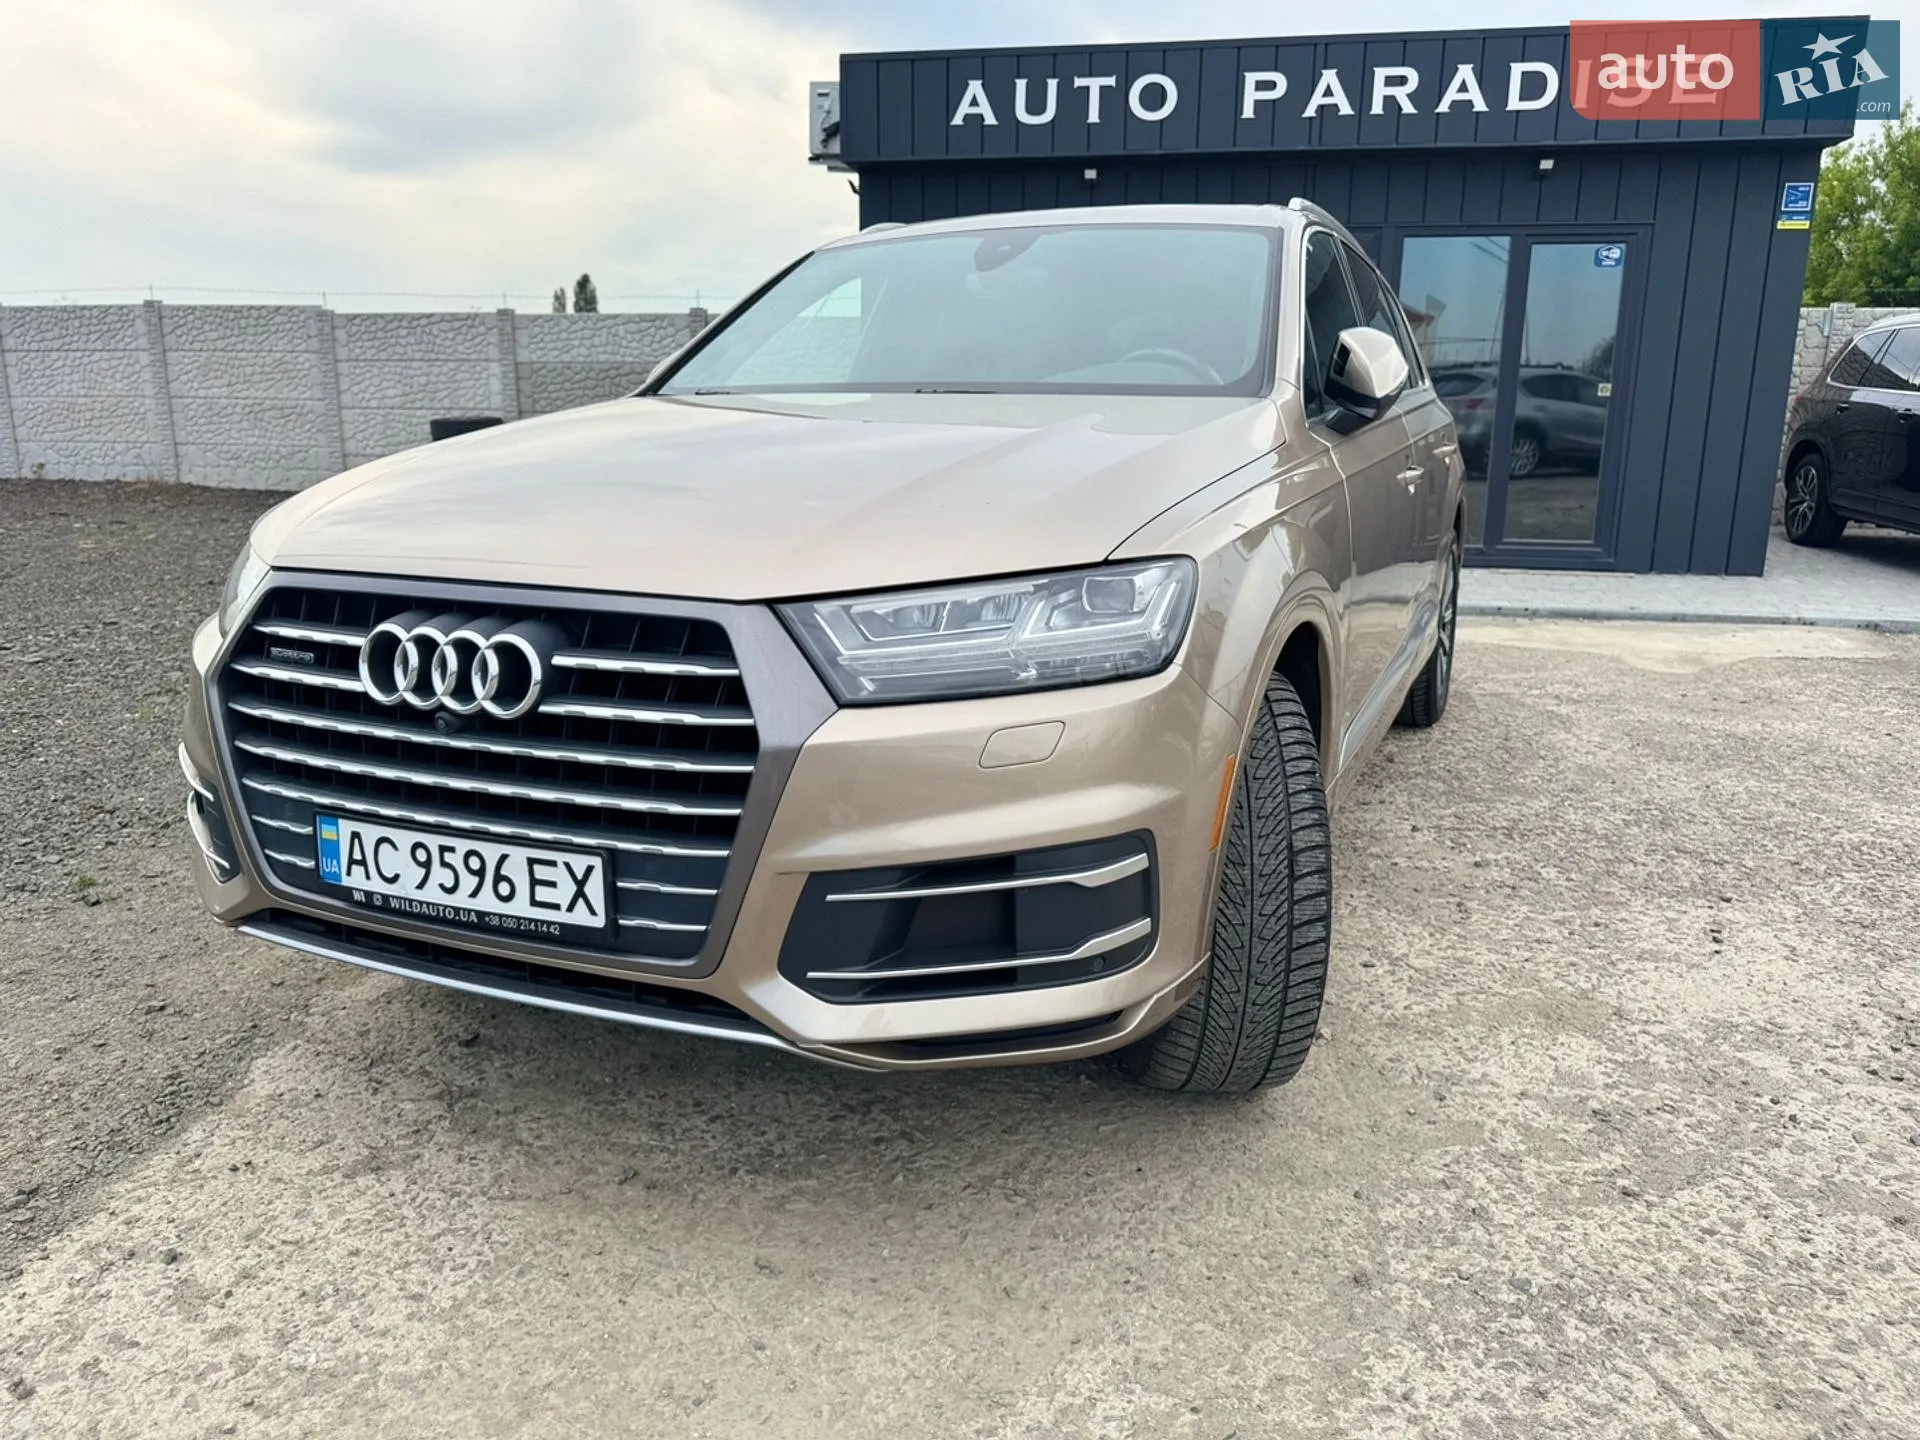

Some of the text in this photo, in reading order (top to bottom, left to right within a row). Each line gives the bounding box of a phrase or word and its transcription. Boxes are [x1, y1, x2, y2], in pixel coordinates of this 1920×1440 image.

[949, 73, 1179, 126] AUTO
[322, 855, 340, 874] UA
[388, 896, 478, 923] WILDAUTO.UA
